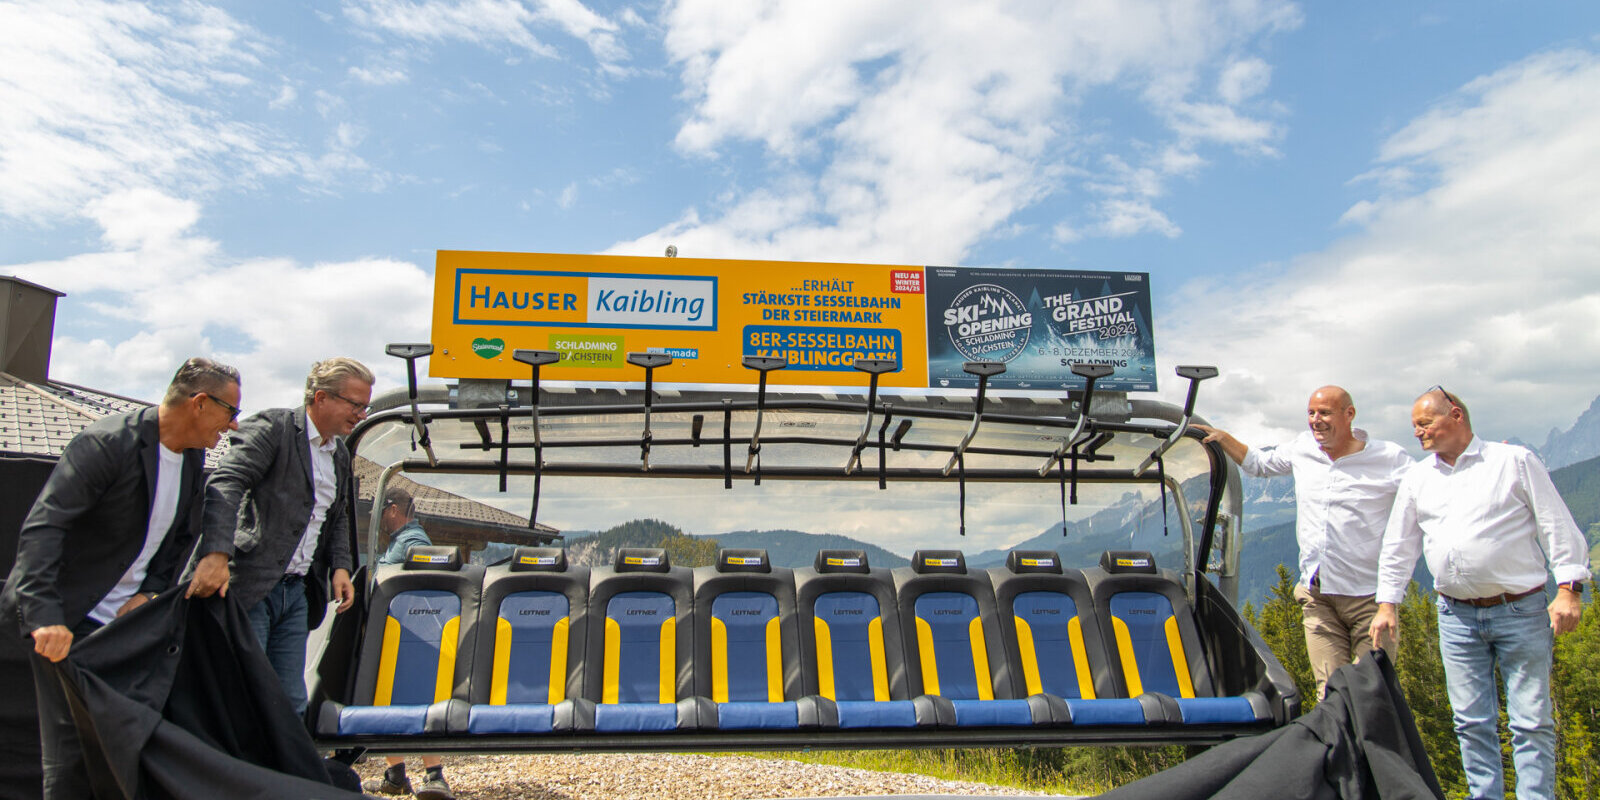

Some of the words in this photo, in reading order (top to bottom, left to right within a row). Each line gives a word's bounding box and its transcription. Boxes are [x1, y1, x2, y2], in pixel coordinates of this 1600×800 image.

[470, 285, 577, 311] HAUSER
[596, 289, 705, 322] Kaibling
[742, 290, 810, 307] STÄRKSTE
[814, 295, 901, 309] SESSELBAHN
[1043, 293, 1072, 308] THE
[762, 308, 790, 321] DER
[794, 310, 882, 323] STEIERMARK
[943, 304, 987, 326] SKI-
[1052, 297, 1123, 322] GRAND
[958, 312, 1032, 337] OPENING
[1069, 311, 1135, 332] FESTIVAL
[1099, 321, 1137, 340] 2024
[555, 340, 617, 351] SCHLADMING
[750, 332, 895, 350] 8ER-SESSELBAHN
[965, 331, 1016, 346] SCHLADMING
[971, 340, 1015, 354] DACHSTEIN
[560, 351, 612, 362] DACHSTEIN
[1038, 347, 1047, 356] 6.
[1053, 347, 1062, 356] 8.
[1064, 347, 1118, 357] DEZEMBER
